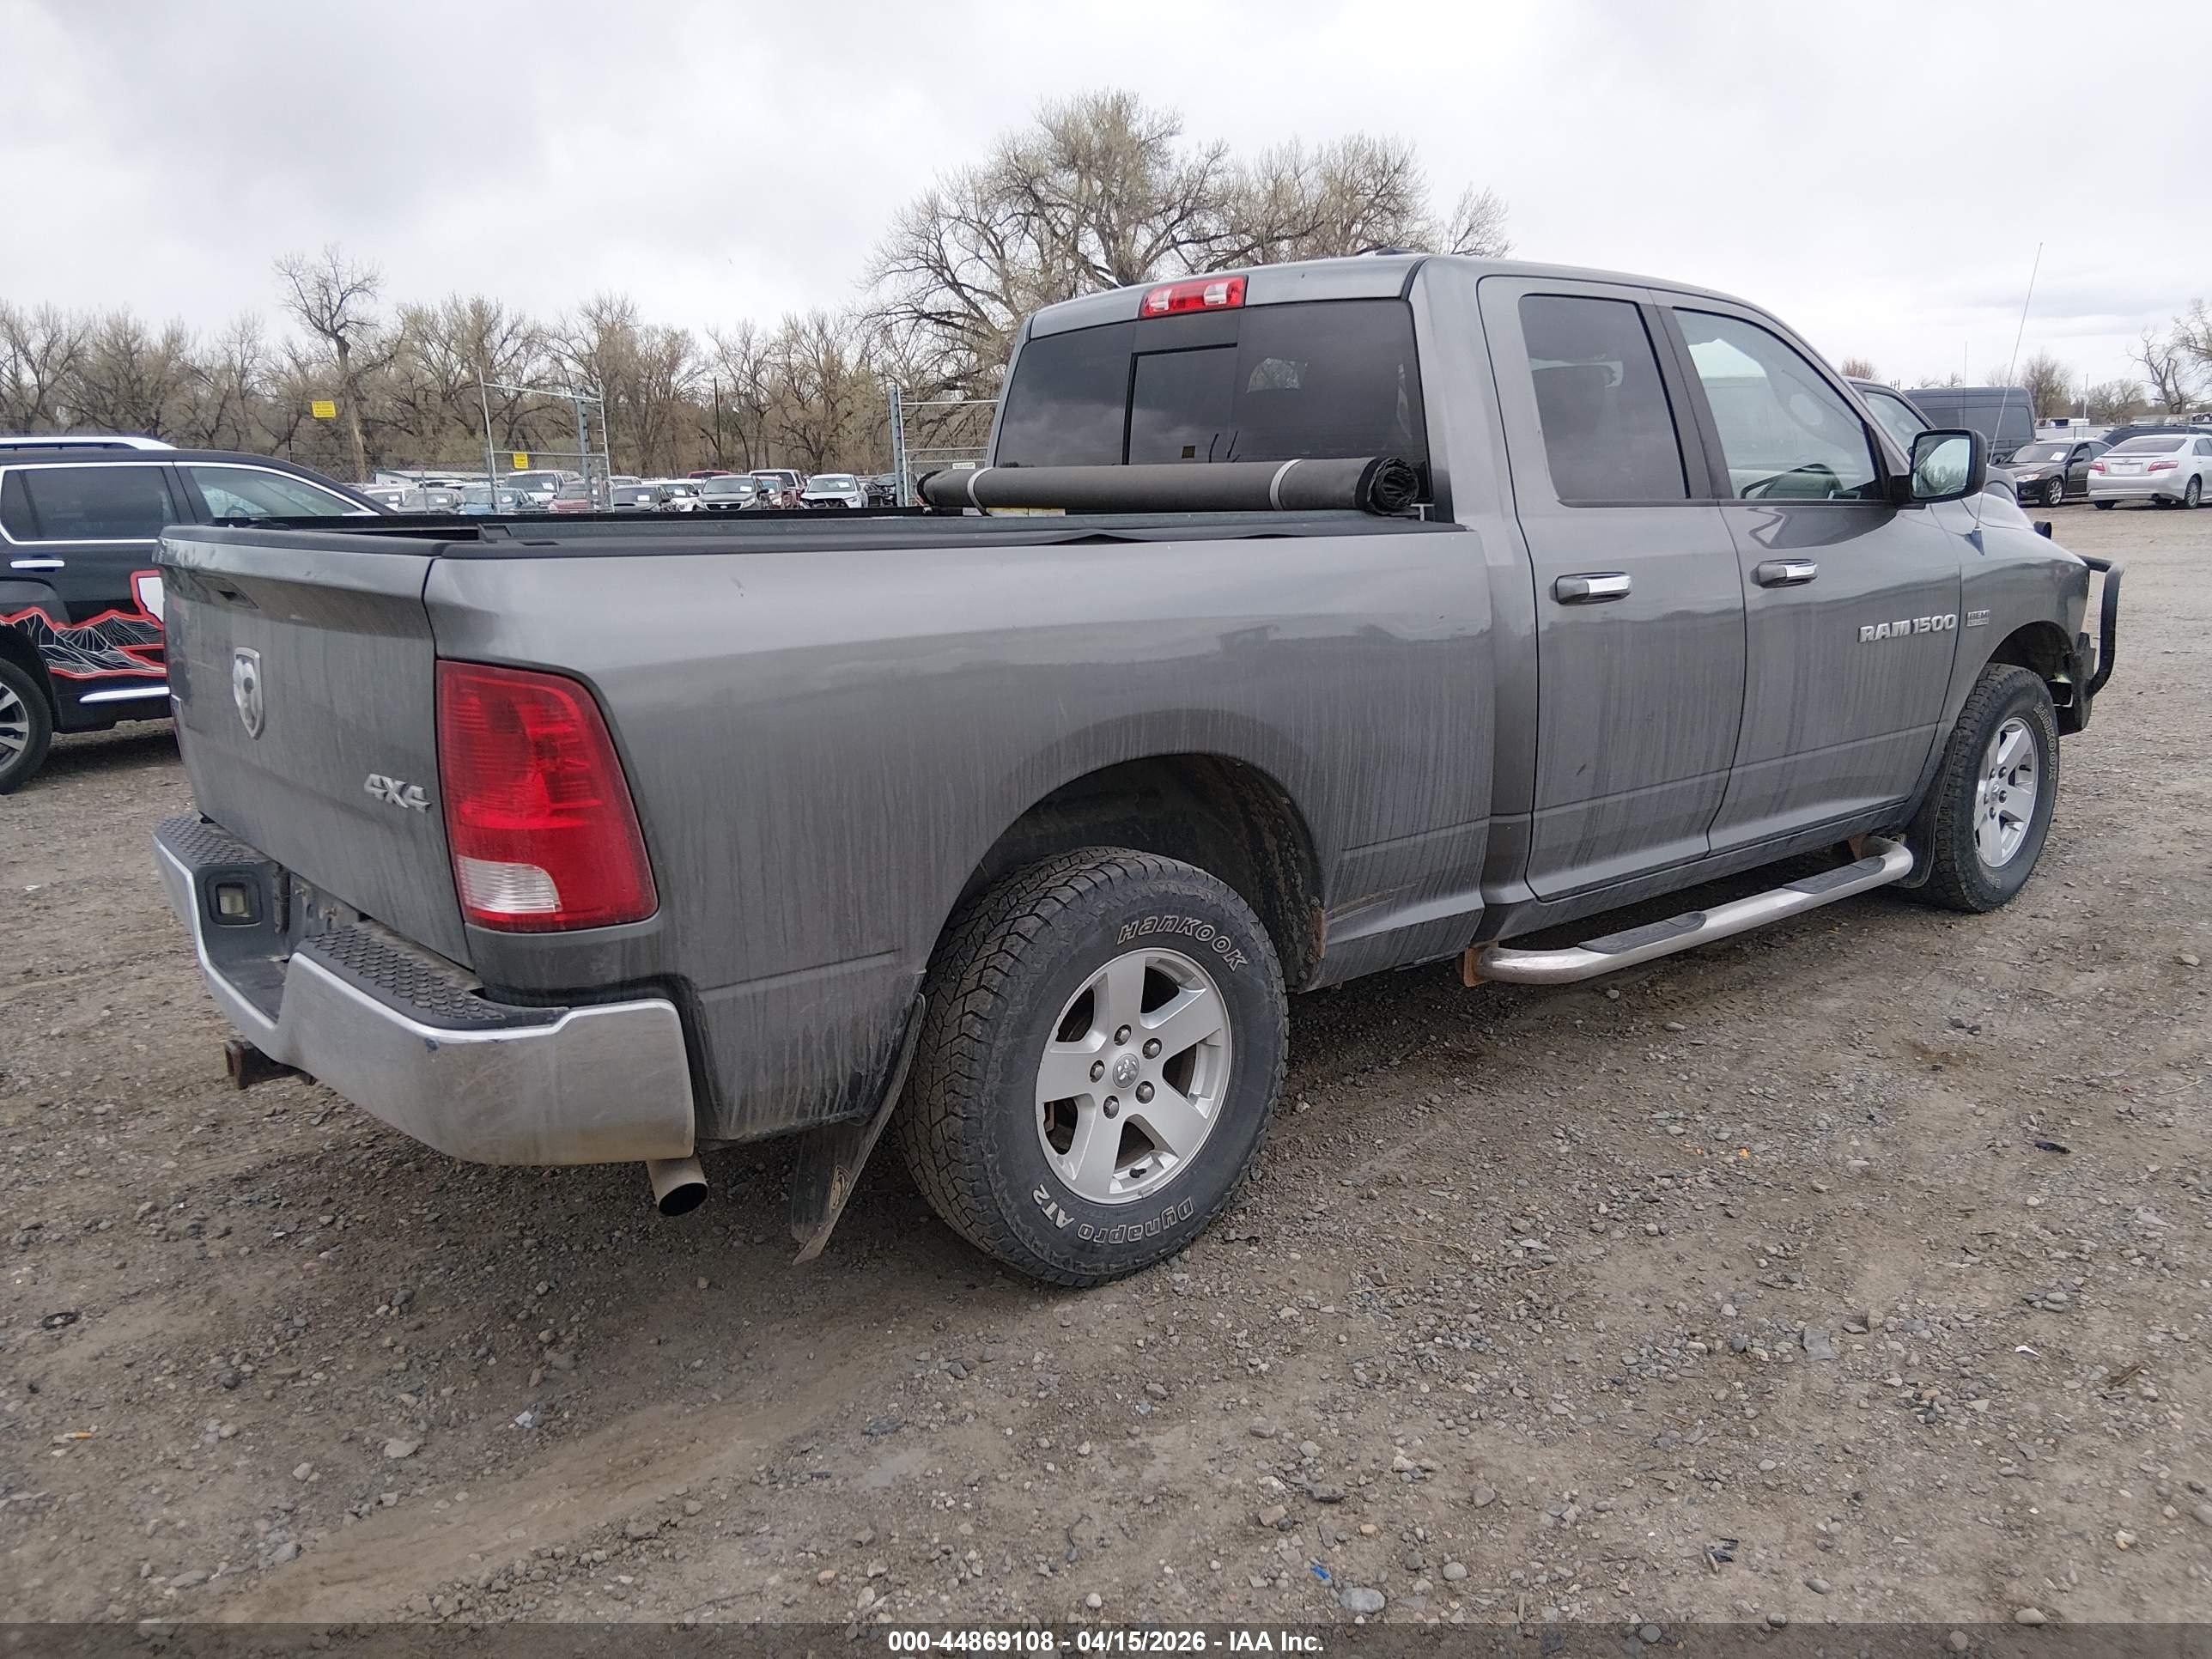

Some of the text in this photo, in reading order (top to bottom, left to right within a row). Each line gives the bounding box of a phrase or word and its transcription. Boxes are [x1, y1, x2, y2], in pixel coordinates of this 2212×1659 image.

[1859, 614, 1957, 642] RAM 1500
[1032, 1183, 1194, 1244] Dynapro AT2
